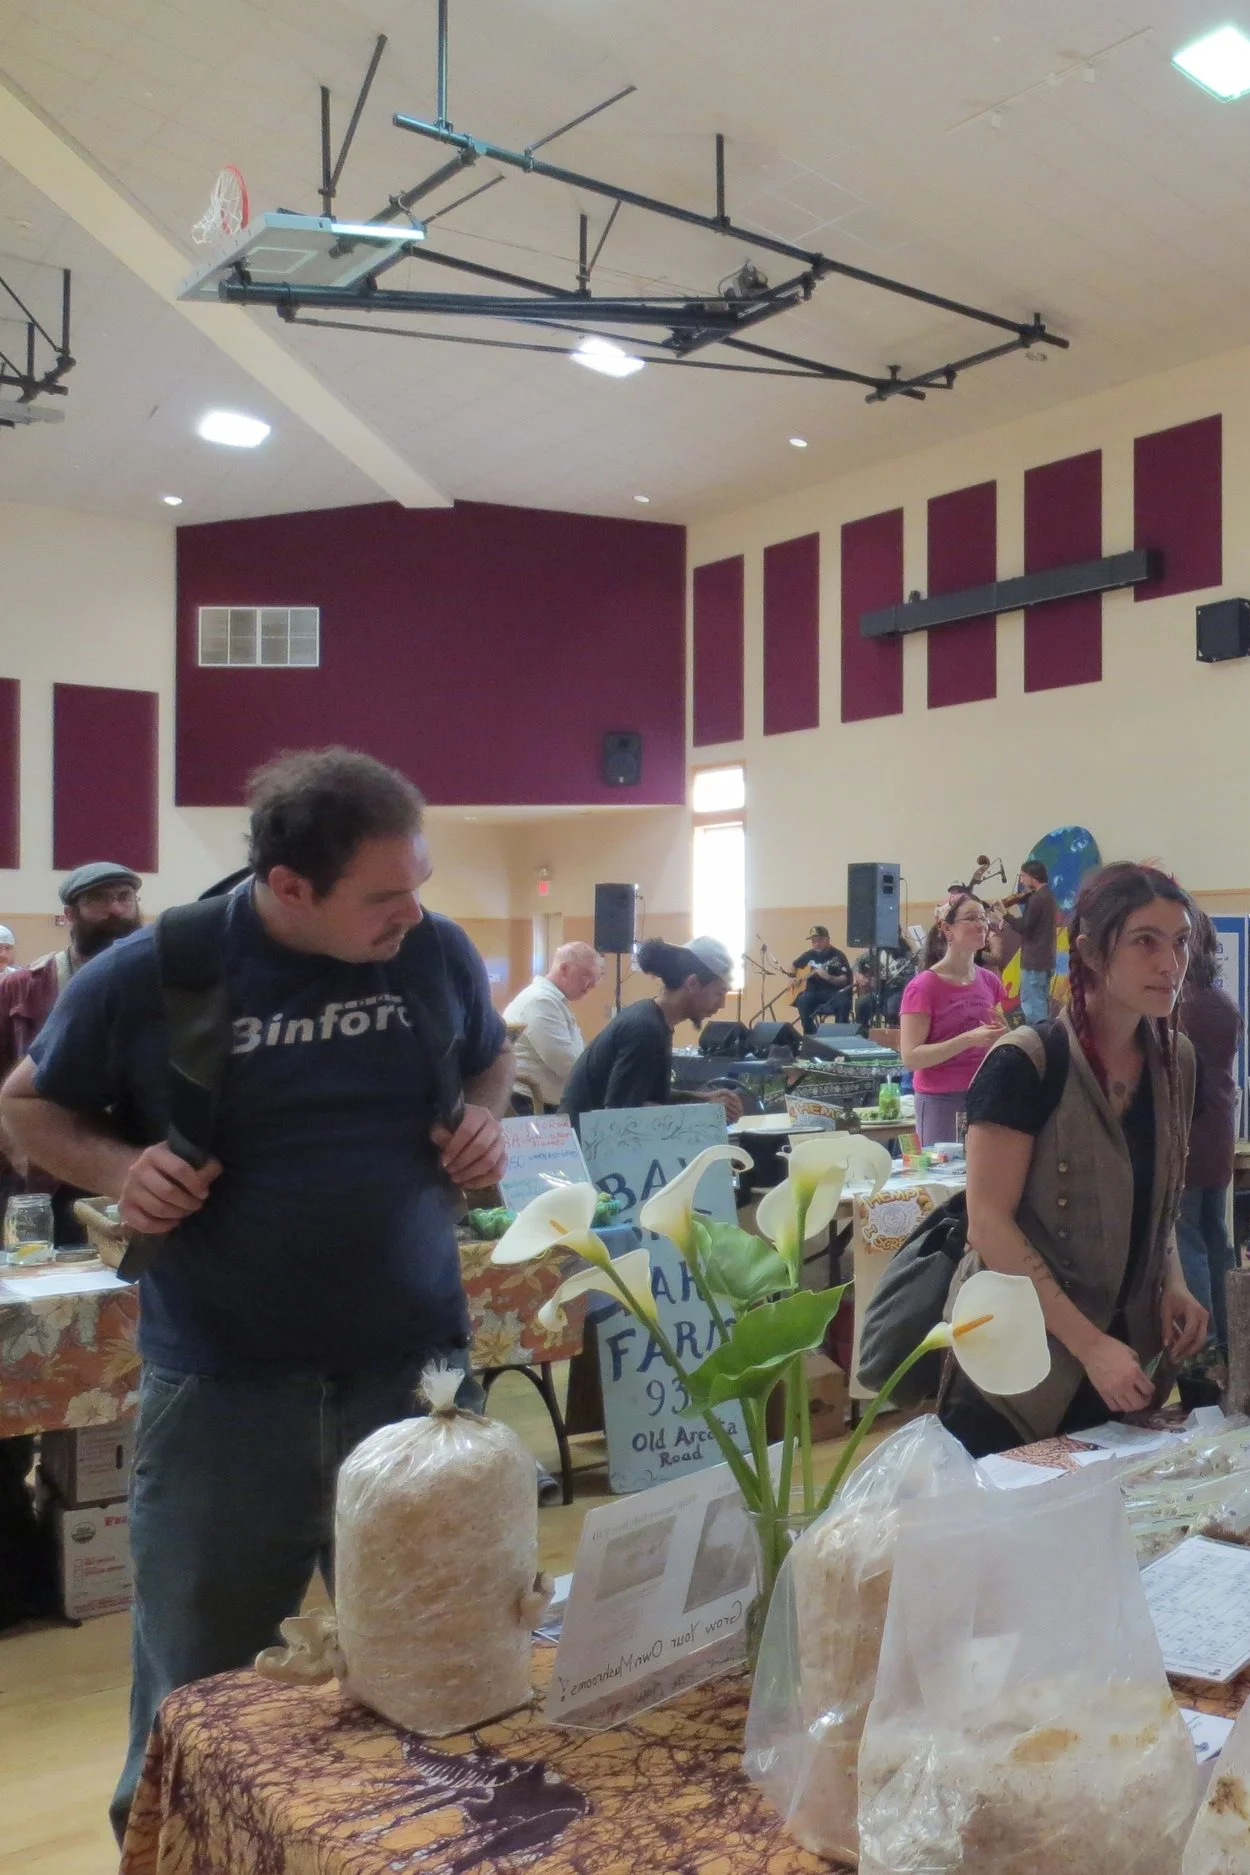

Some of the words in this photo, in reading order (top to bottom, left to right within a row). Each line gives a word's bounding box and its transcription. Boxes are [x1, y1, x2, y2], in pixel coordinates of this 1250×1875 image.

[232, 993, 412, 1055] Binfor
[632, 1427, 666, 1452] Old
[659, 1444, 703, 1469] Road
